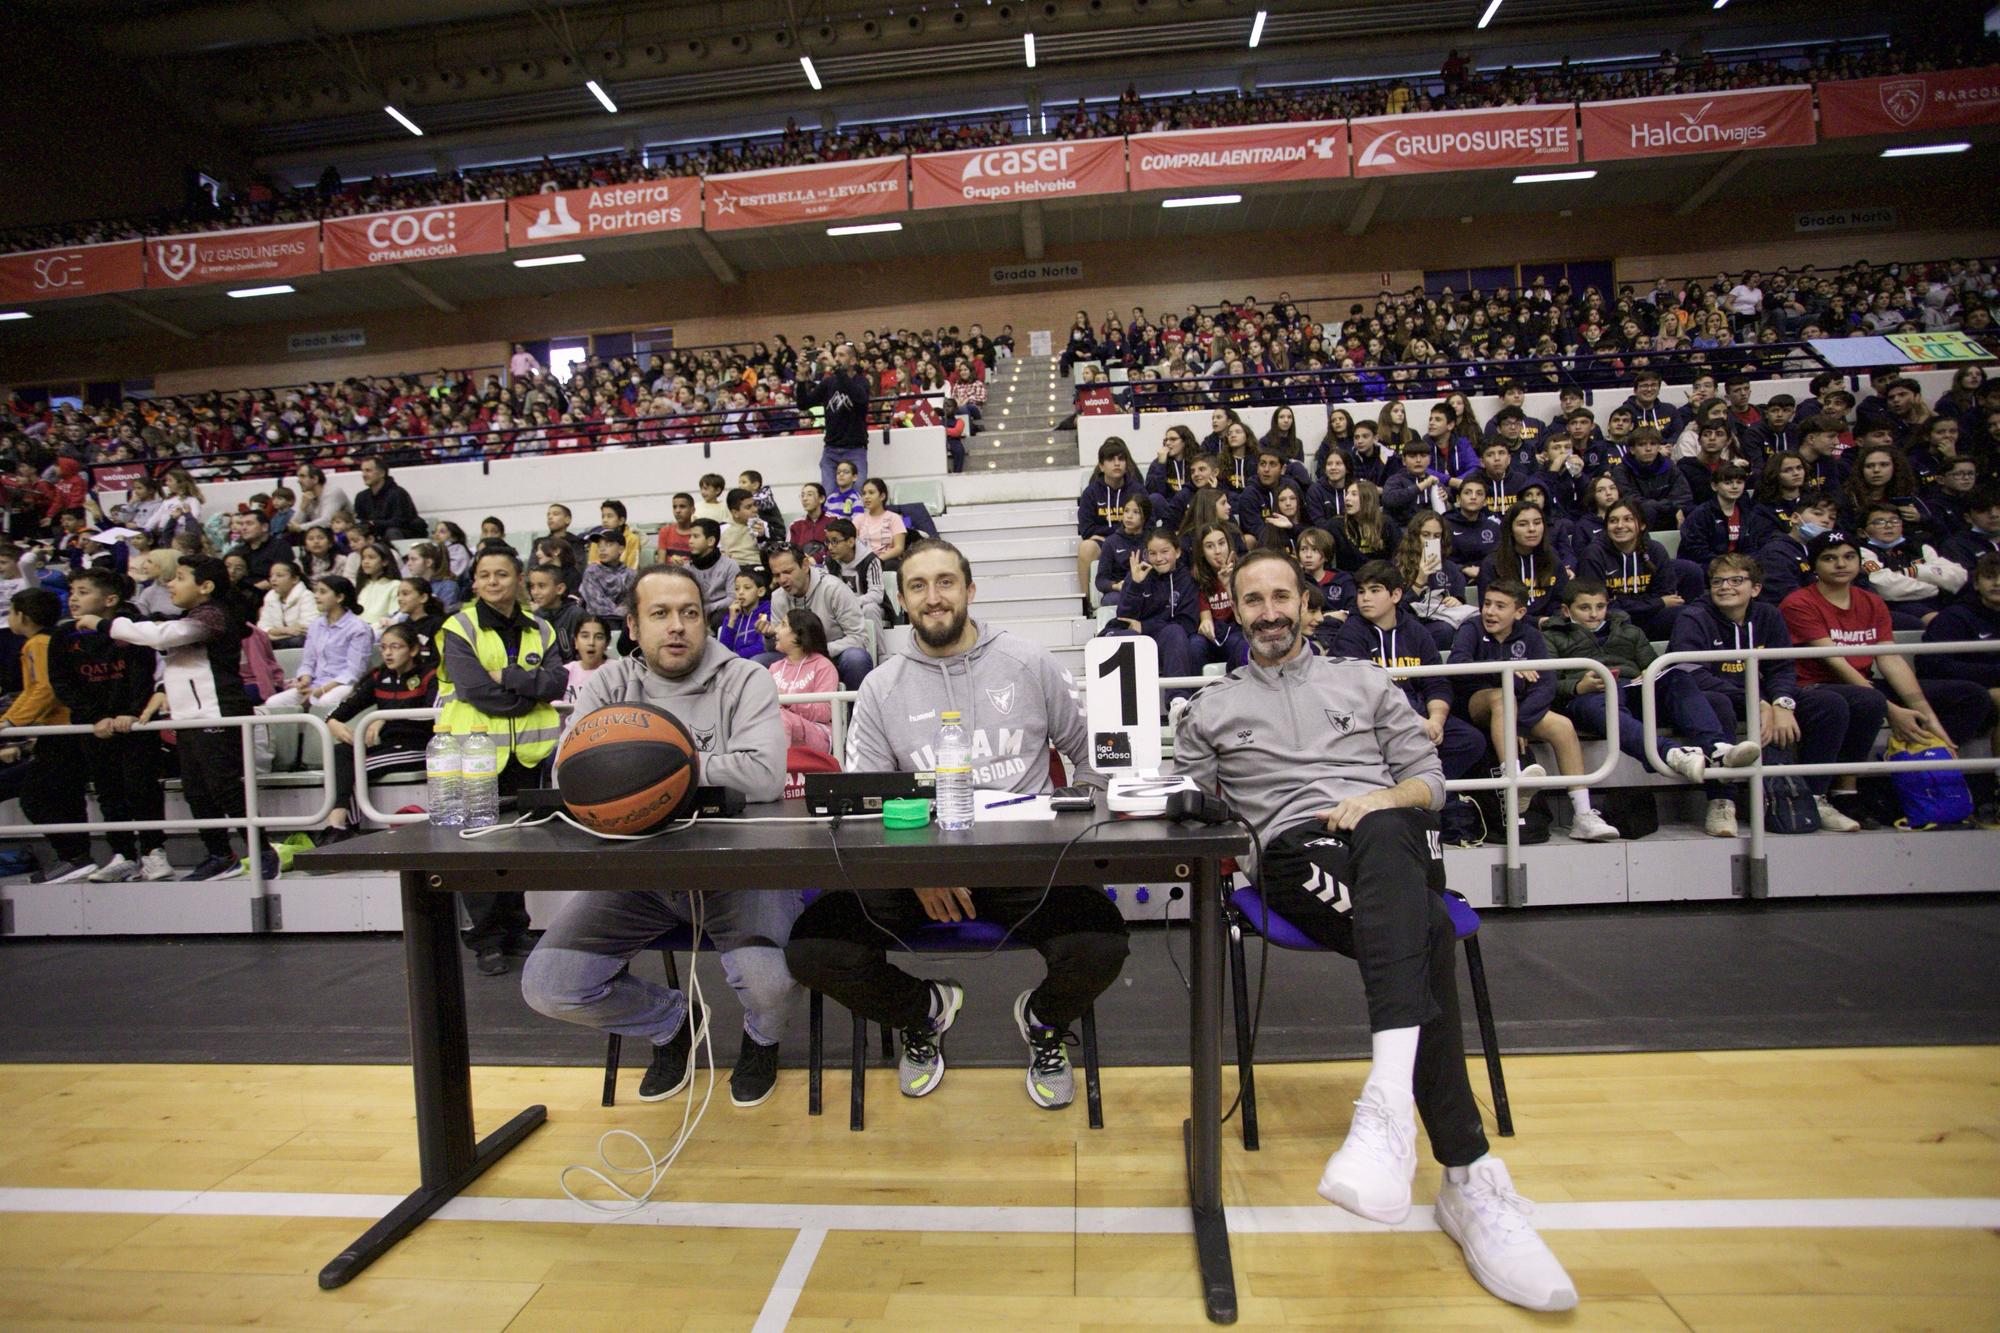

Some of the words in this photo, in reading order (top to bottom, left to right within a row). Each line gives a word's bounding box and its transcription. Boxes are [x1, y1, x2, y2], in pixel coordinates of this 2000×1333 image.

[1396, 126, 1569, 156] GRUPOSURESTE
[985, 147, 1074, 177] caser
[1141, 146, 1306, 171] COMPRALAENTRADA
[588, 186, 668, 209] Asterra
[739, 190, 815, 207] ESTRELLA
[829, 180, 898, 198] LEVANTE
[963, 184, 1010, 200] Grupo
[1014, 179, 1076, 194] Helvetia
[588, 205, 681, 232] Partners
[1799, 213, 1846, 227] Grada
[217, 241, 305, 262] GASOLINERAS
[33, 254, 85, 290] SGE
[994, 269, 1037, 281] Grada
[1042, 265, 1078, 277] Norte
[1098, 641, 1139, 726] 1
[1096, 745, 1113, 753] liga
[1097, 752, 1131, 760] endesa
